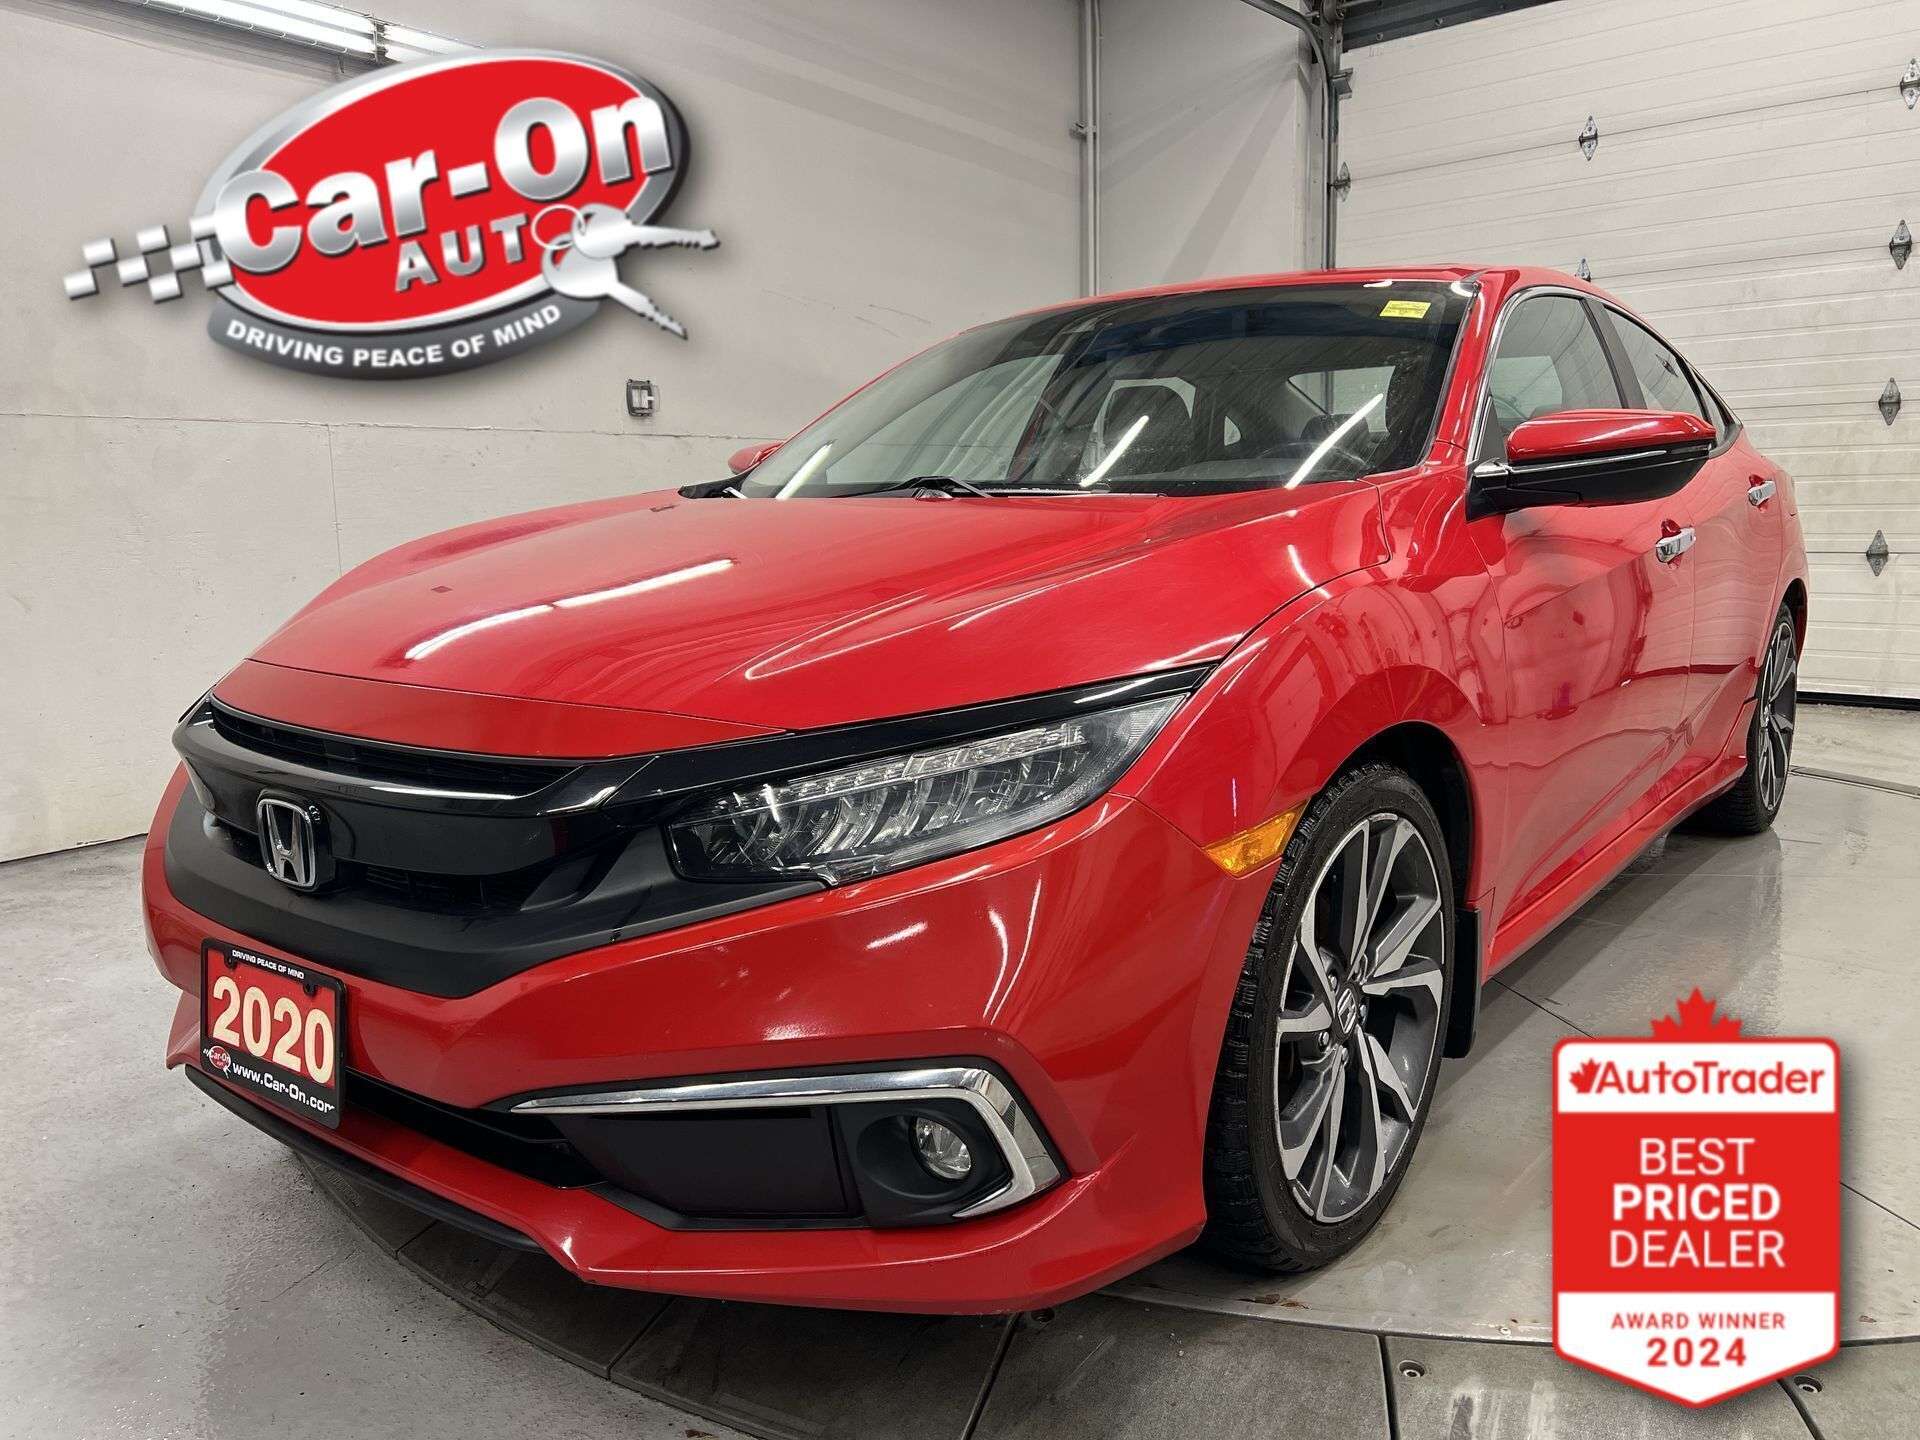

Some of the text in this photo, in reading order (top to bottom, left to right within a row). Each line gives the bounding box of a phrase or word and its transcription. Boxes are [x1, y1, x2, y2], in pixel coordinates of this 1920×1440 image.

[232, 949, 305, 979] DRIVING PEACE OF MIND
[212, 975, 334, 1084] 2020
